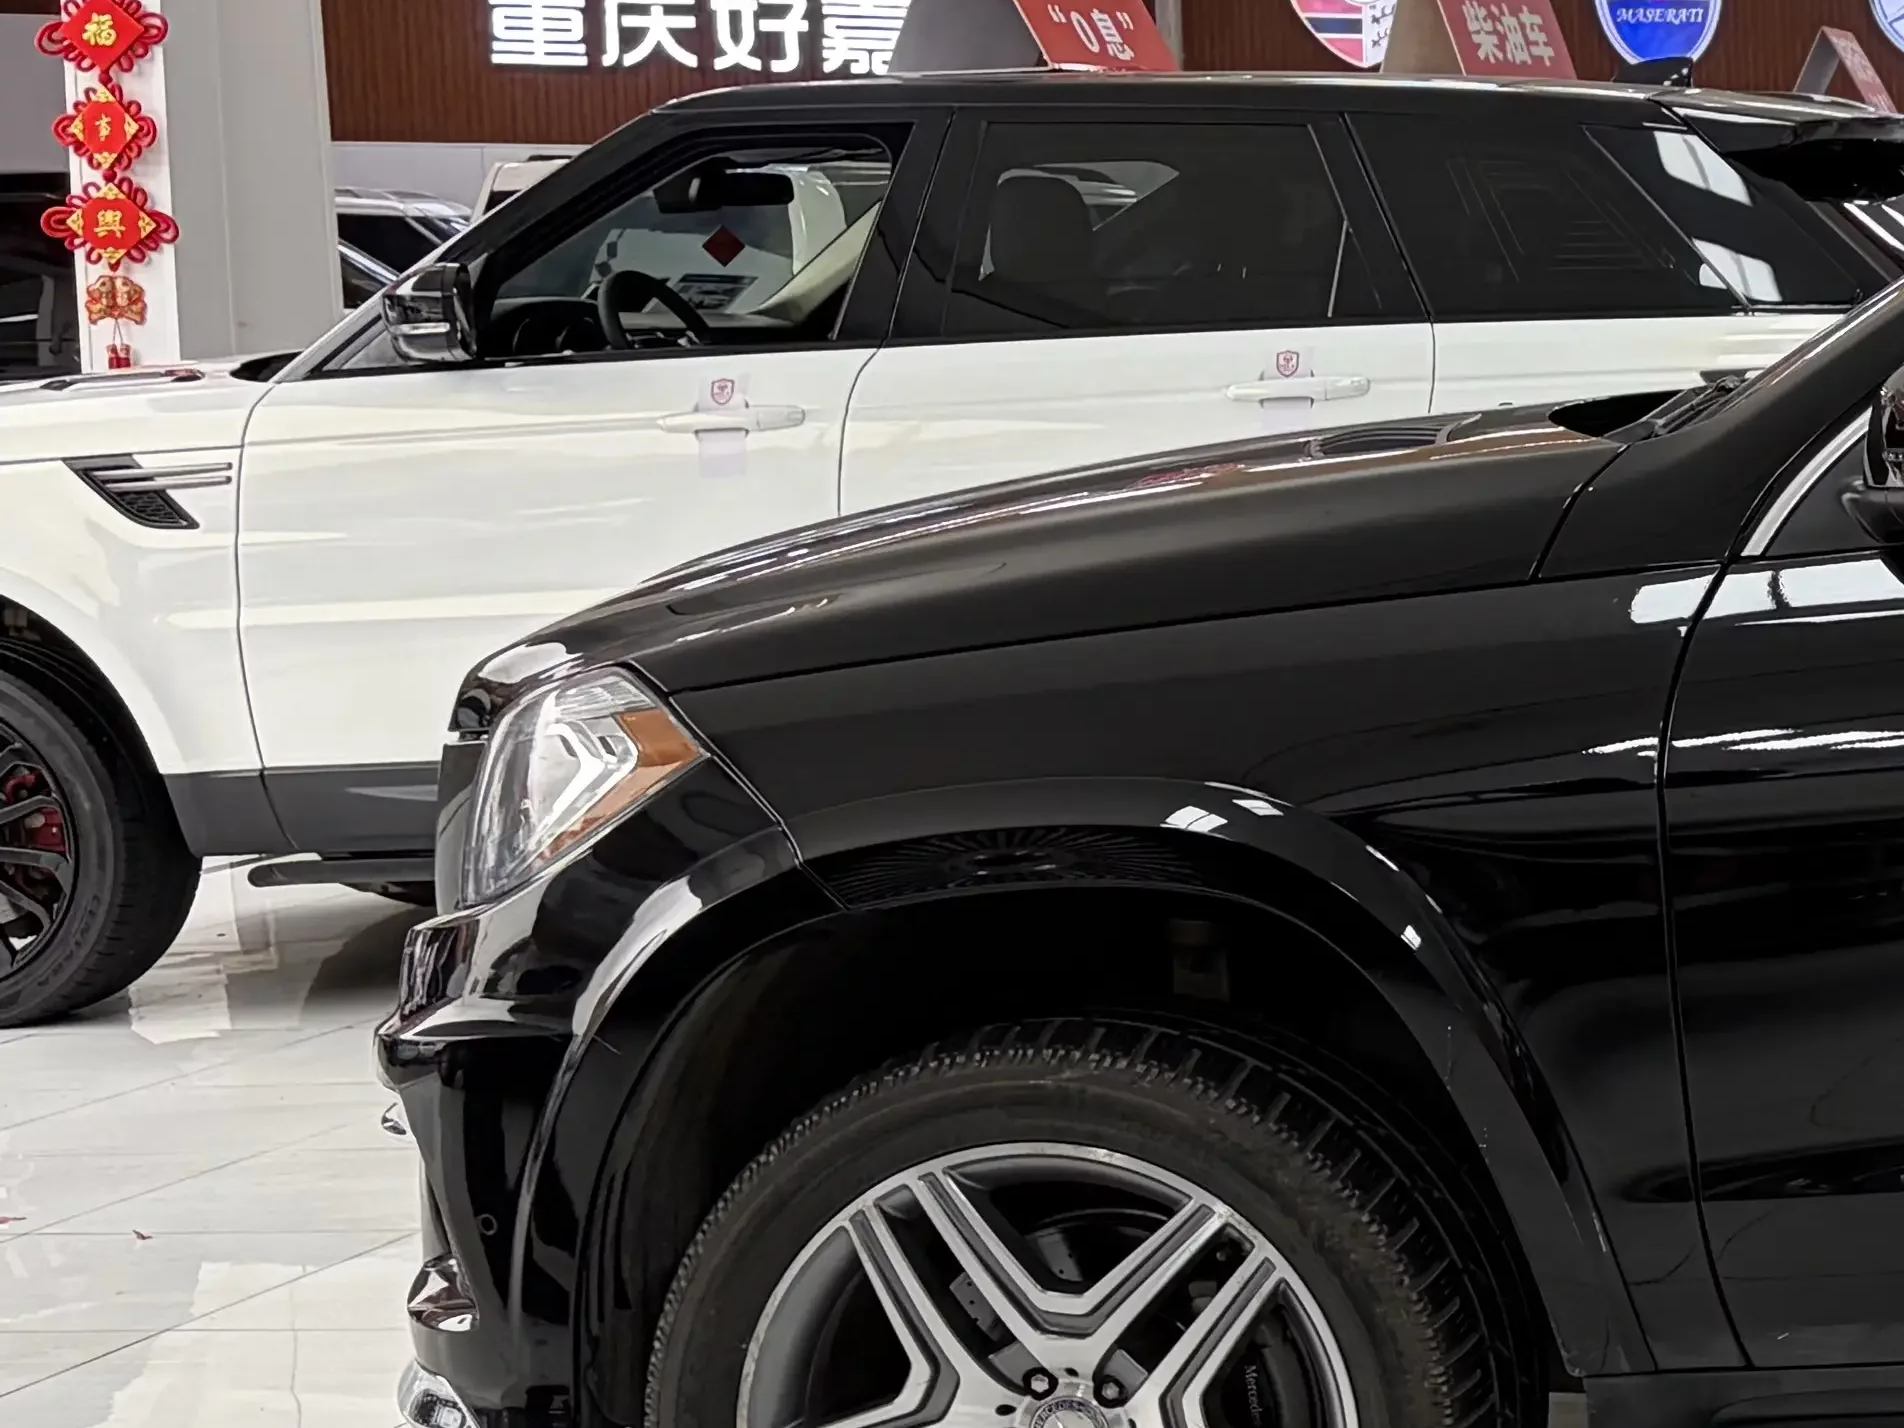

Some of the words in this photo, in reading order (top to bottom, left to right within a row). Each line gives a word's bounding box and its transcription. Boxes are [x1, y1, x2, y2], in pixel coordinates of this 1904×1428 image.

[1461, 0, 1556, 68] 柴油车
[1615, 6, 1704, 24] MASERATI
